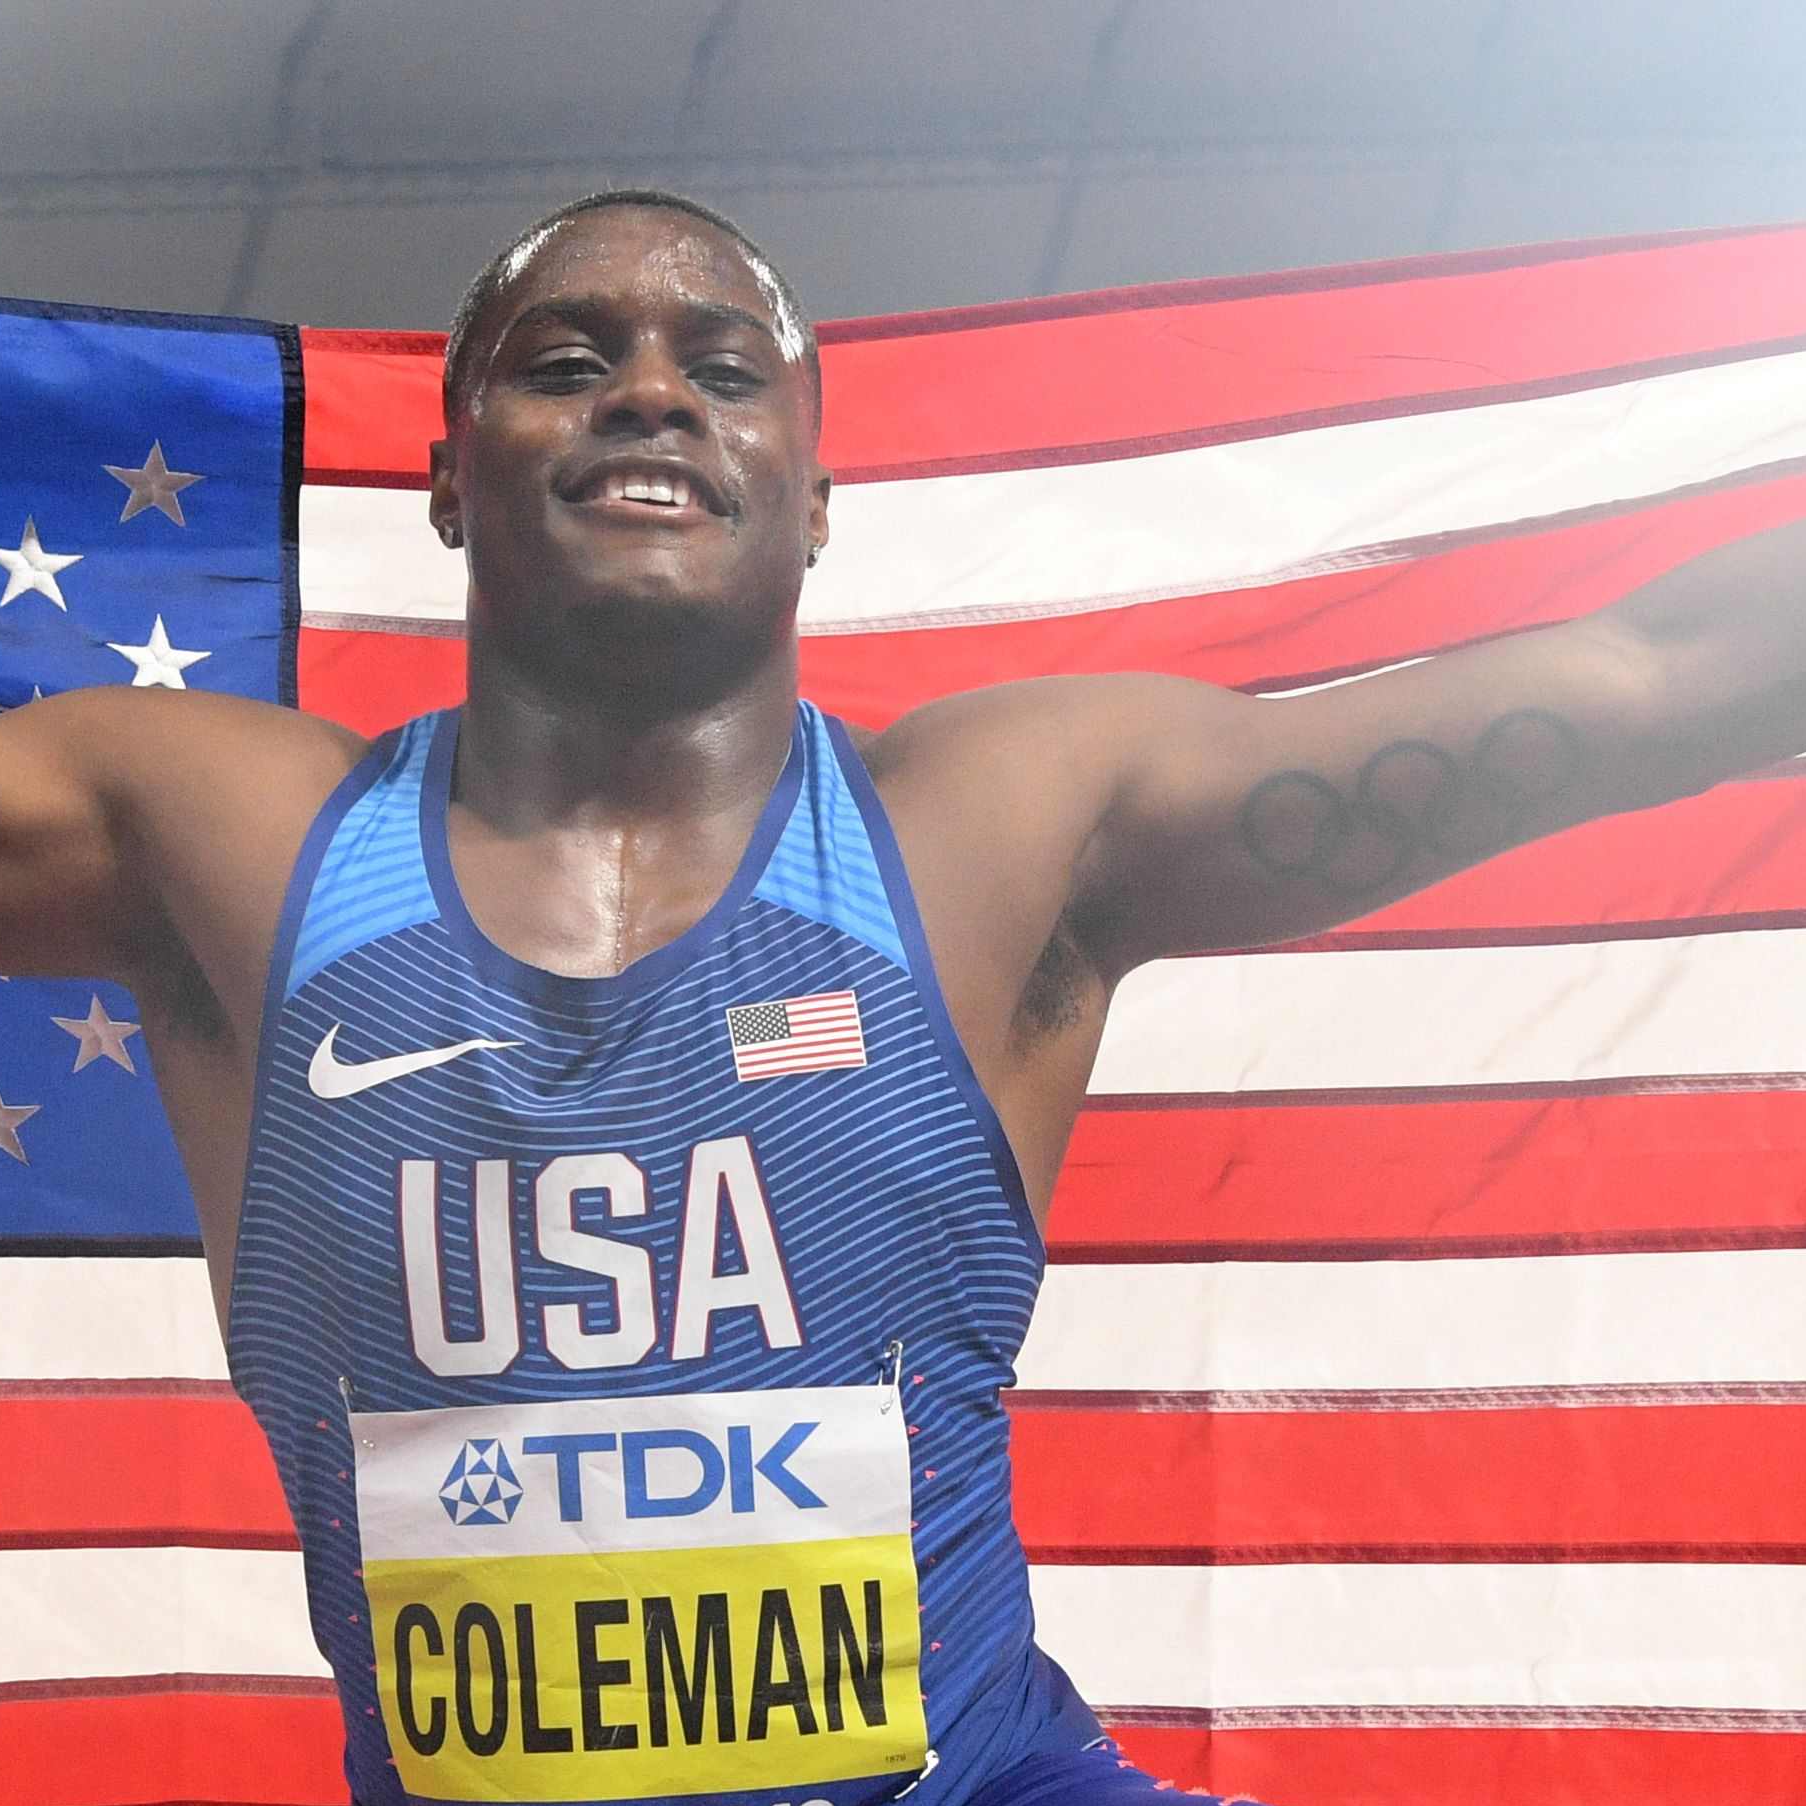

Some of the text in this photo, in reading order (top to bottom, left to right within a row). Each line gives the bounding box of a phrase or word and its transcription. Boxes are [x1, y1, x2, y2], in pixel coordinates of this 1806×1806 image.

[401, 1135, 803, 1377] USA
[522, 1421, 828, 1522] TDK
[394, 1580, 888, 1756] COLEMAN
